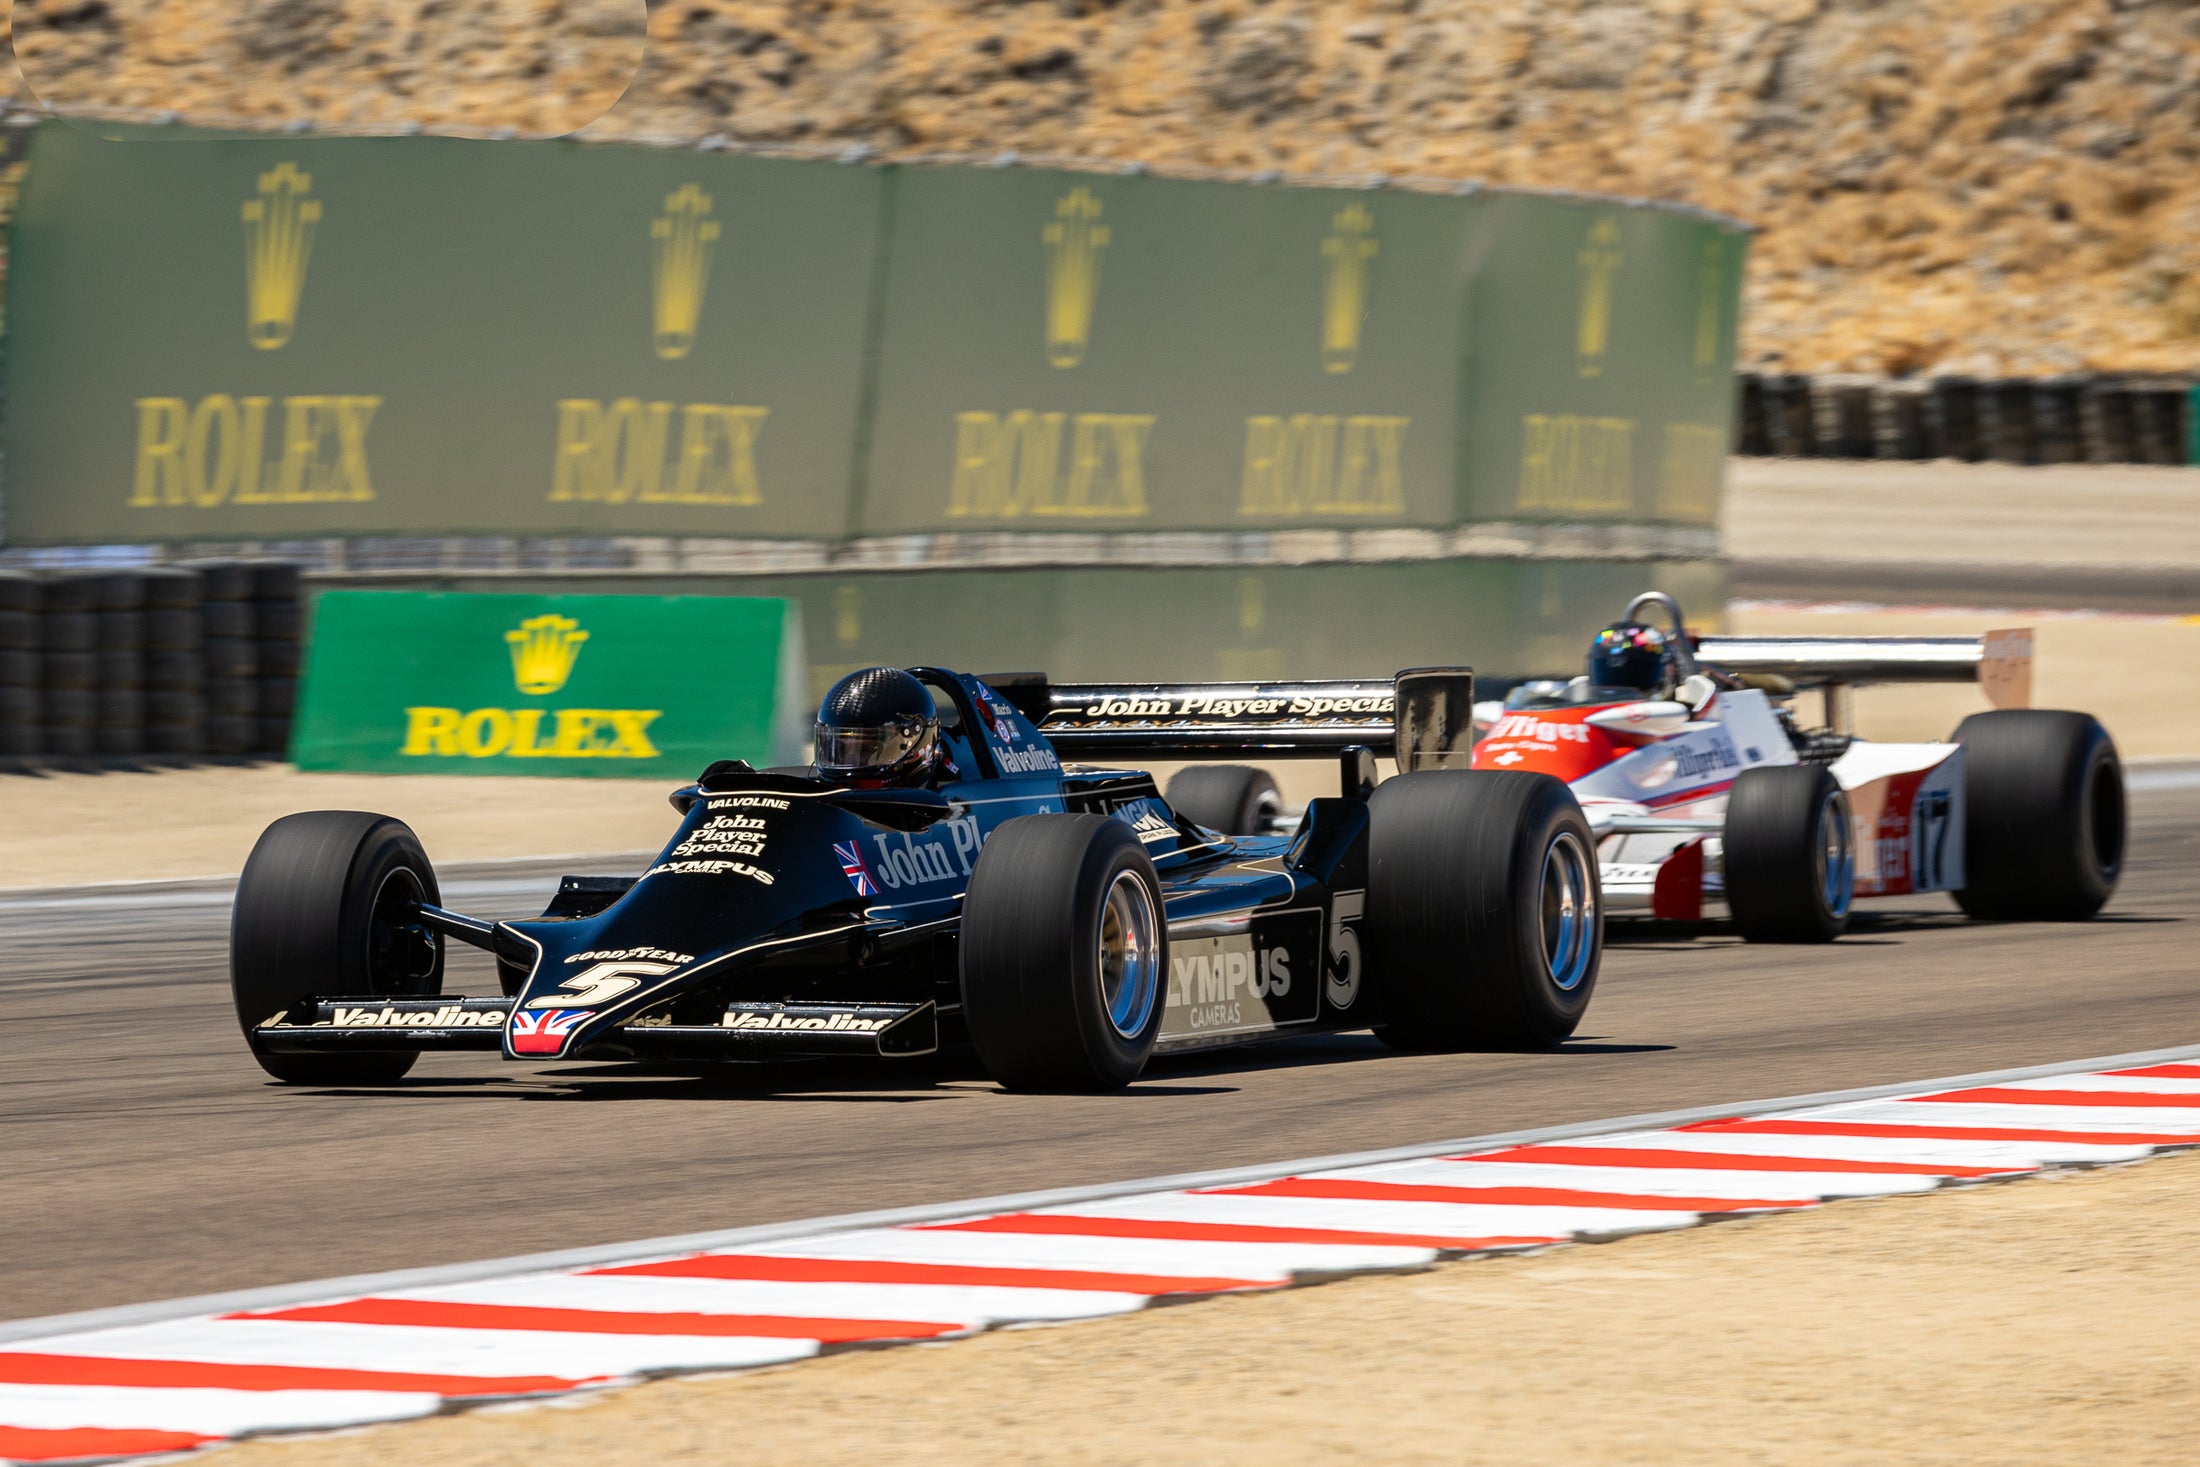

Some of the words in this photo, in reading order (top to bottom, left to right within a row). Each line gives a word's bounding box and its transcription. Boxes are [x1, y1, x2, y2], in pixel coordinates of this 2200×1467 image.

[127, 392, 383, 508] ROLEX
[547, 396, 770, 506] ROLEX
[946, 409, 1158, 518] ROLEX
[1237, 413, 1411, 517] ROLEX
[1086, 695, 1171, 717] John
[1175, 696, 1288, 717] Player
[1288, 694, 1395, 717] Specia
[399, 706, 664, 758] ROLEX
[992, 744, 1059, 774] Valvoline
[703, 814, 766, 829] John
[707, 797, 790, 810] VALVOLINE
[671, 840, 766, 857] Special
[686, 829, 767, 843] Player
[873, 831, 957, 889] John
[1326, 888, 1366, 1010] 5
[524, 961, 681, 1009] 5
[1166, 946, 1291, 1008] YMPUS
[333, 1006, 506, 1027] Valvoline
[1190, 1002, 1241, 1029] CAMERAS
